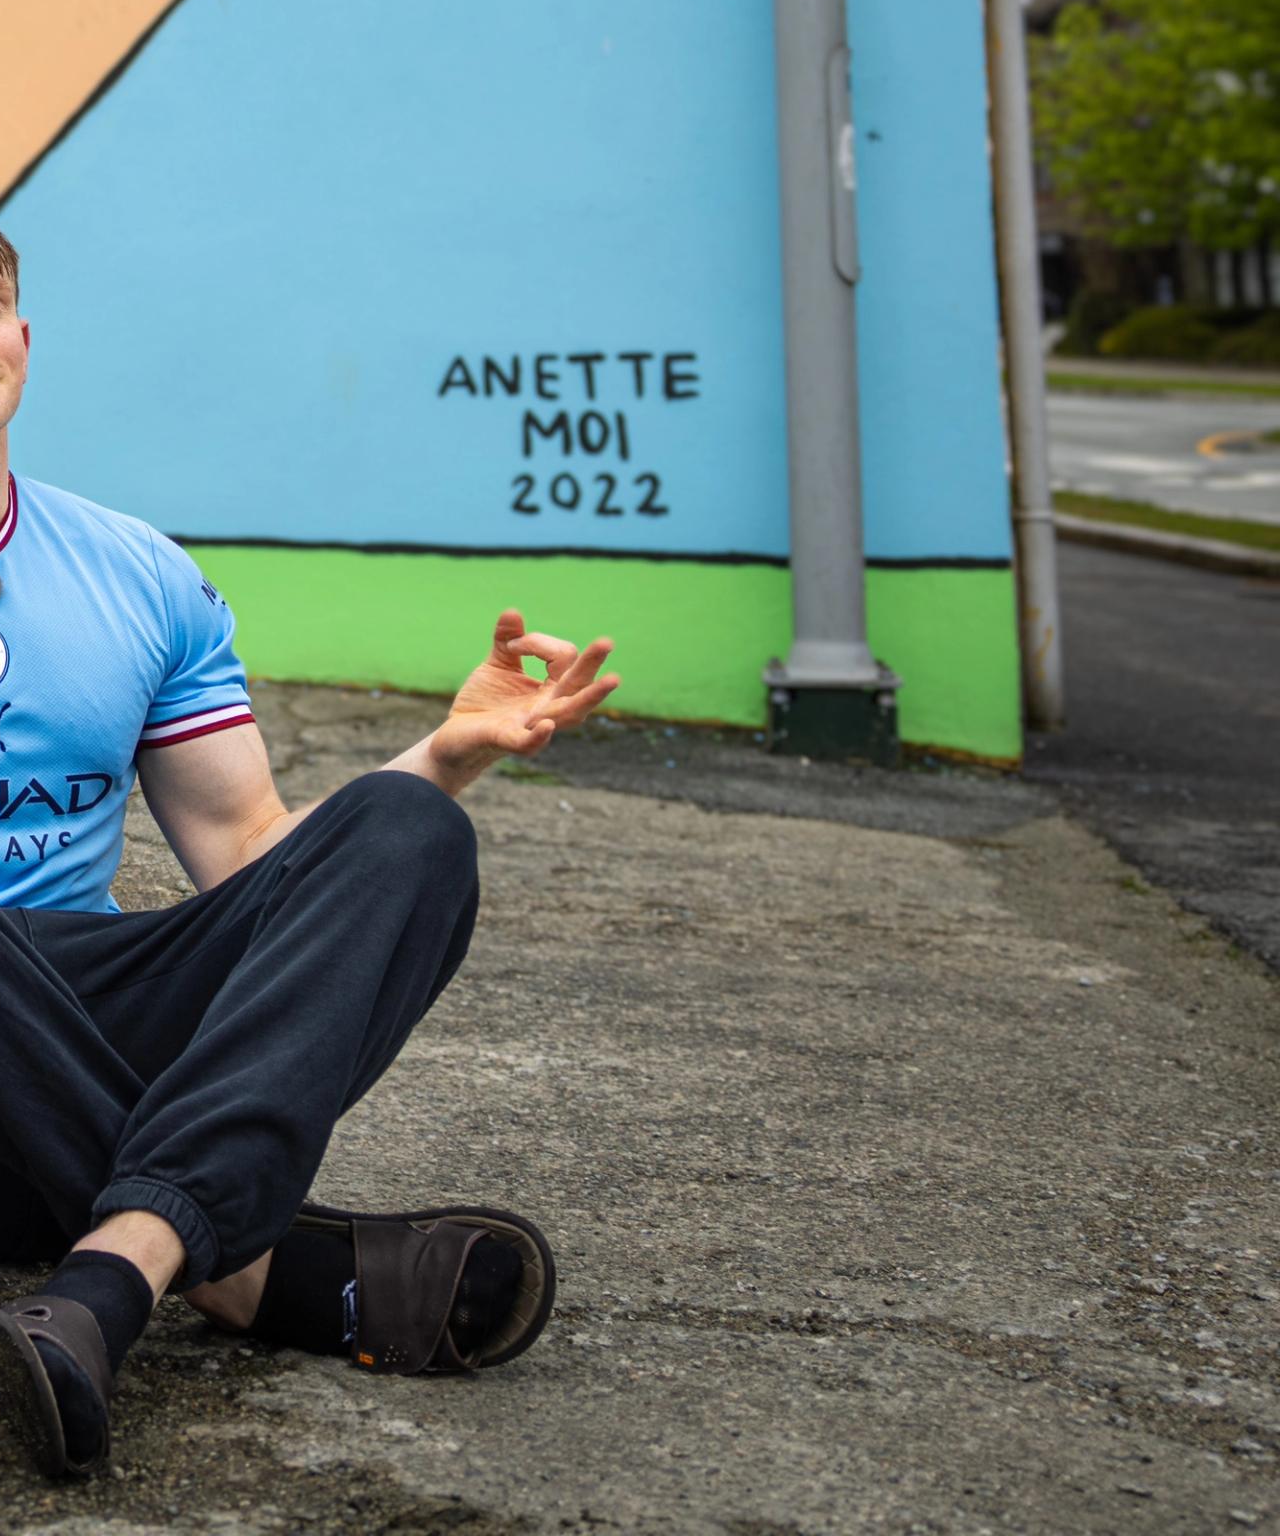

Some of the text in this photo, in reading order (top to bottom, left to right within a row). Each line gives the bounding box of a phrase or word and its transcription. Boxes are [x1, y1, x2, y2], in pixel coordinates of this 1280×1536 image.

[438, 352, 700, 401] ANETTE
[522, 410, 629, 461] MOI
[511, 471, 669, 516] 2022
